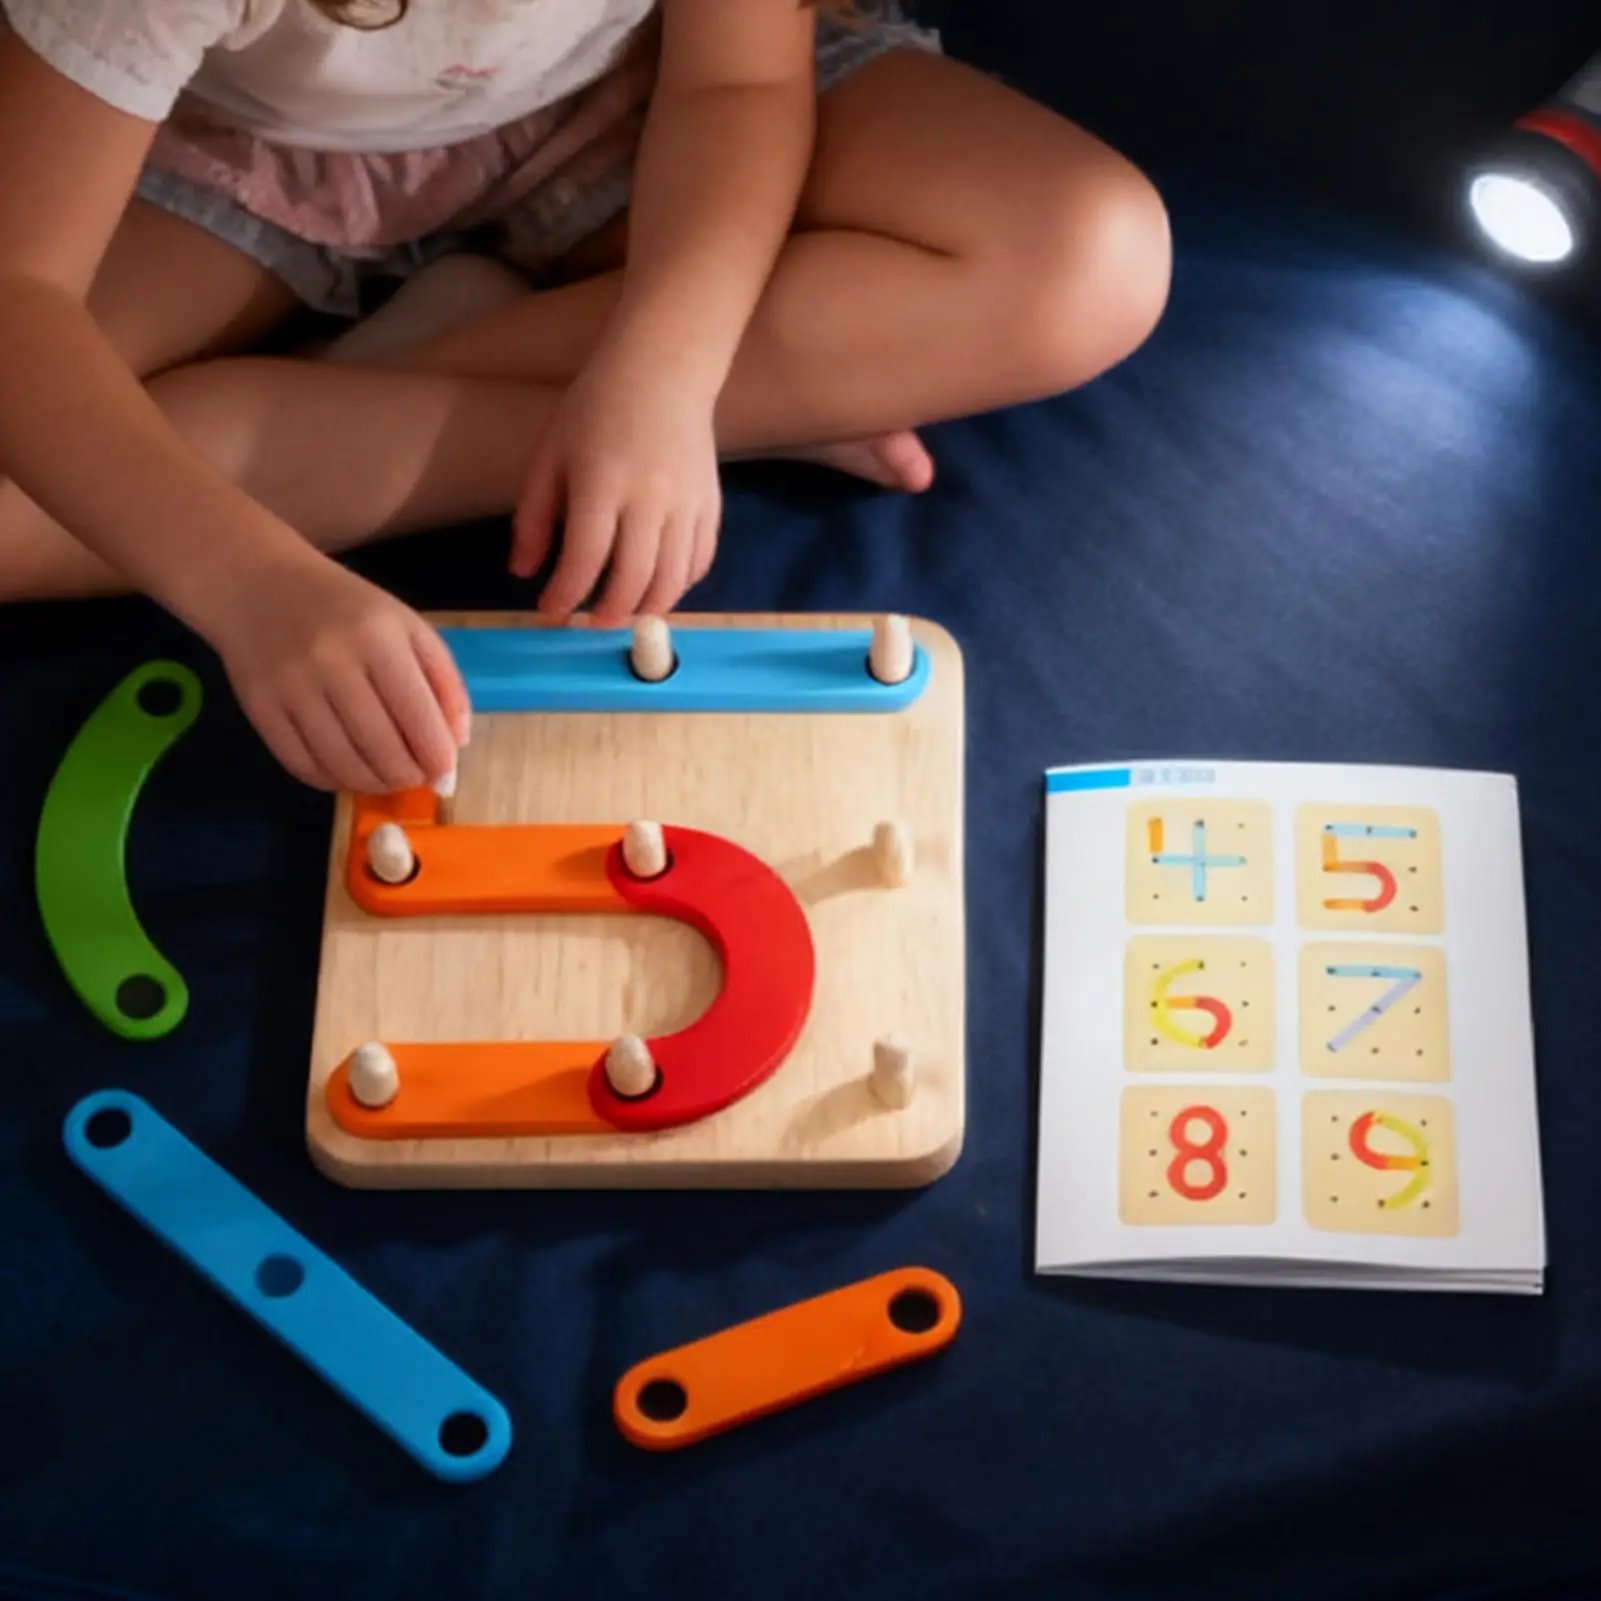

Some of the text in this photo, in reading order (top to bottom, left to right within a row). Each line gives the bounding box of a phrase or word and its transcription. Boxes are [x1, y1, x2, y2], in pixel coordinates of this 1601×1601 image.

[1147, 817, 1247, 901] 4
[1321, 822, 1418, 913] 5
[1149, 957, 1232, 1049] 6
[1325, 965, 1422, 1052] 7
[1167, 1105, 1228, 1201] 8
[1348, 1110, 1429, 1209] 9
